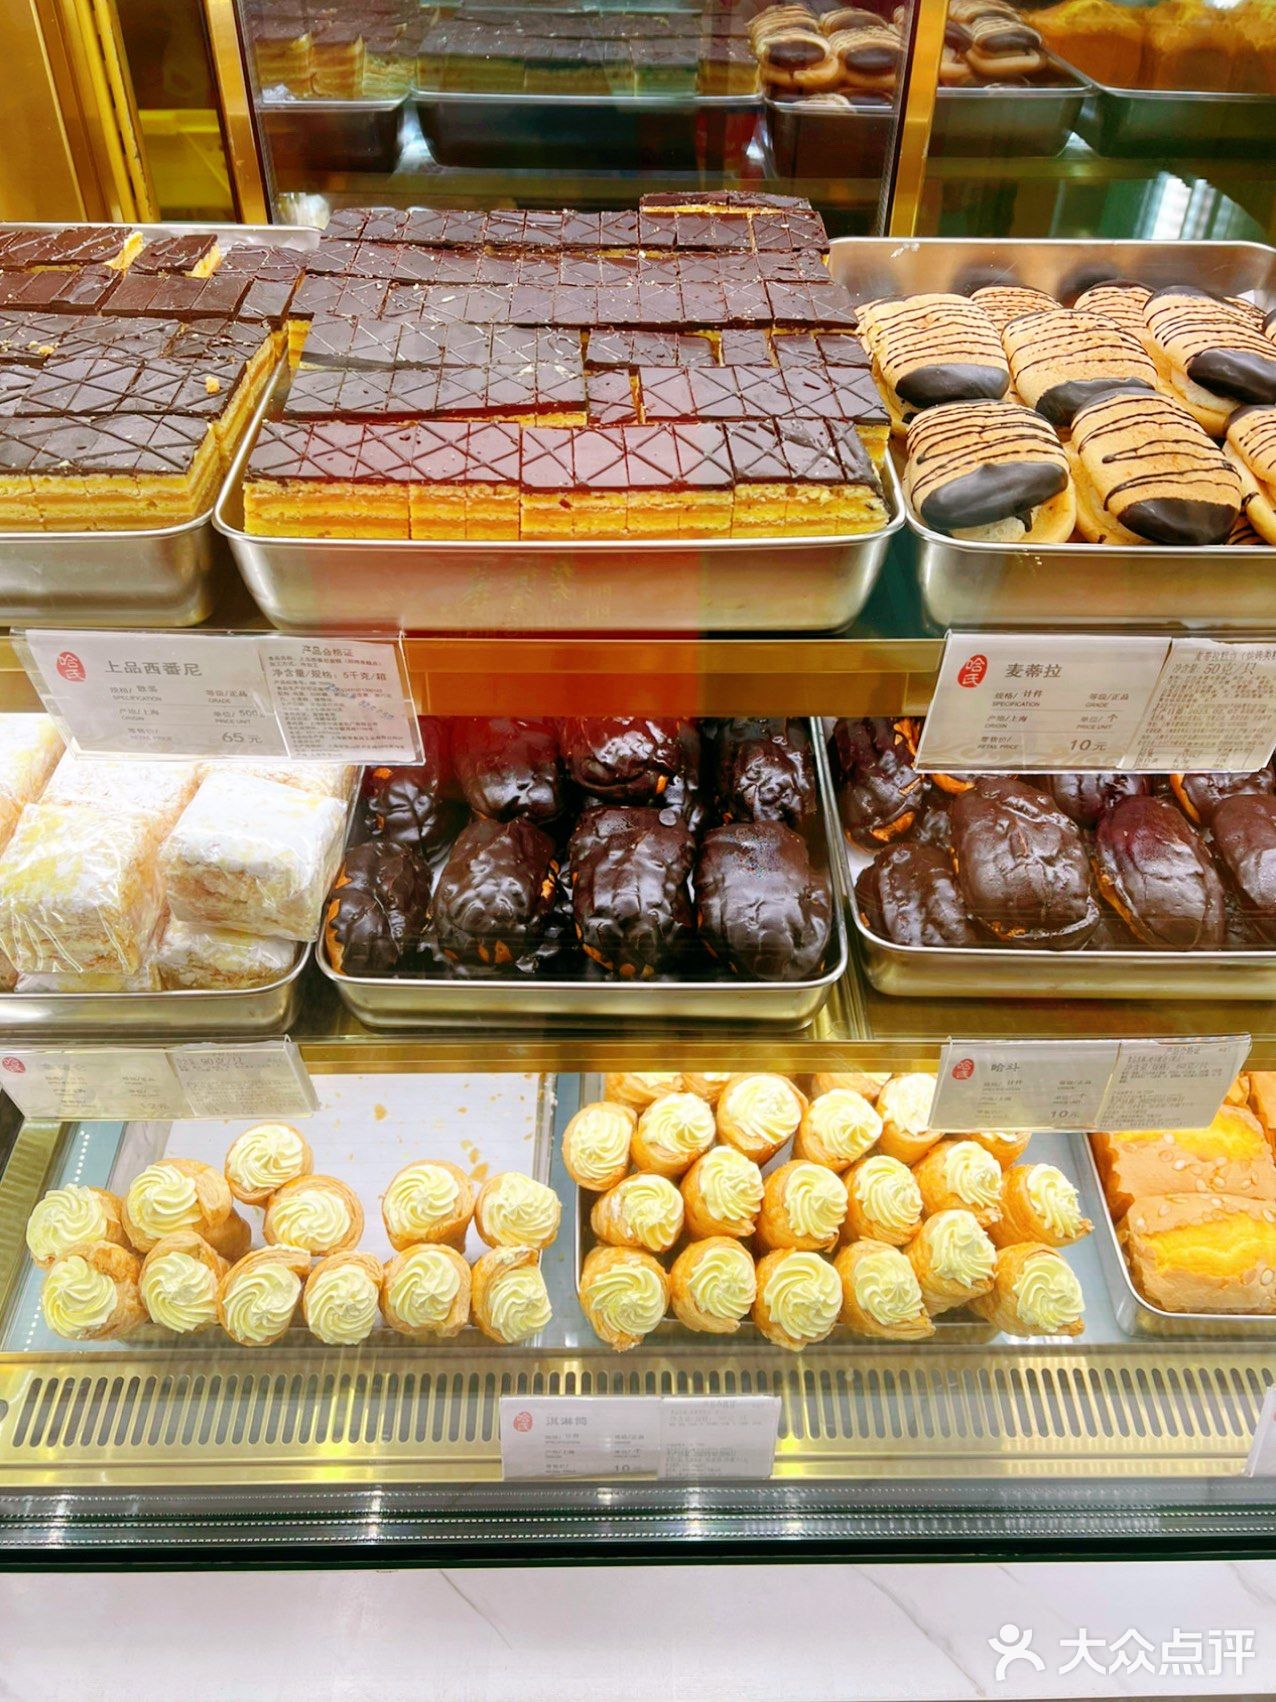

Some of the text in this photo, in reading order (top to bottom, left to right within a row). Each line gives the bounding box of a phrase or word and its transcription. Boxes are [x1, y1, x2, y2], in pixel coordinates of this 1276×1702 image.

[104, 660, 203, 677] 上品西番尼
[962, 657, 986, 686] 哈氏
[1005, 663, 1063, 678] 麦蒂拉
[1069, 739, 1107, 752] 10元
